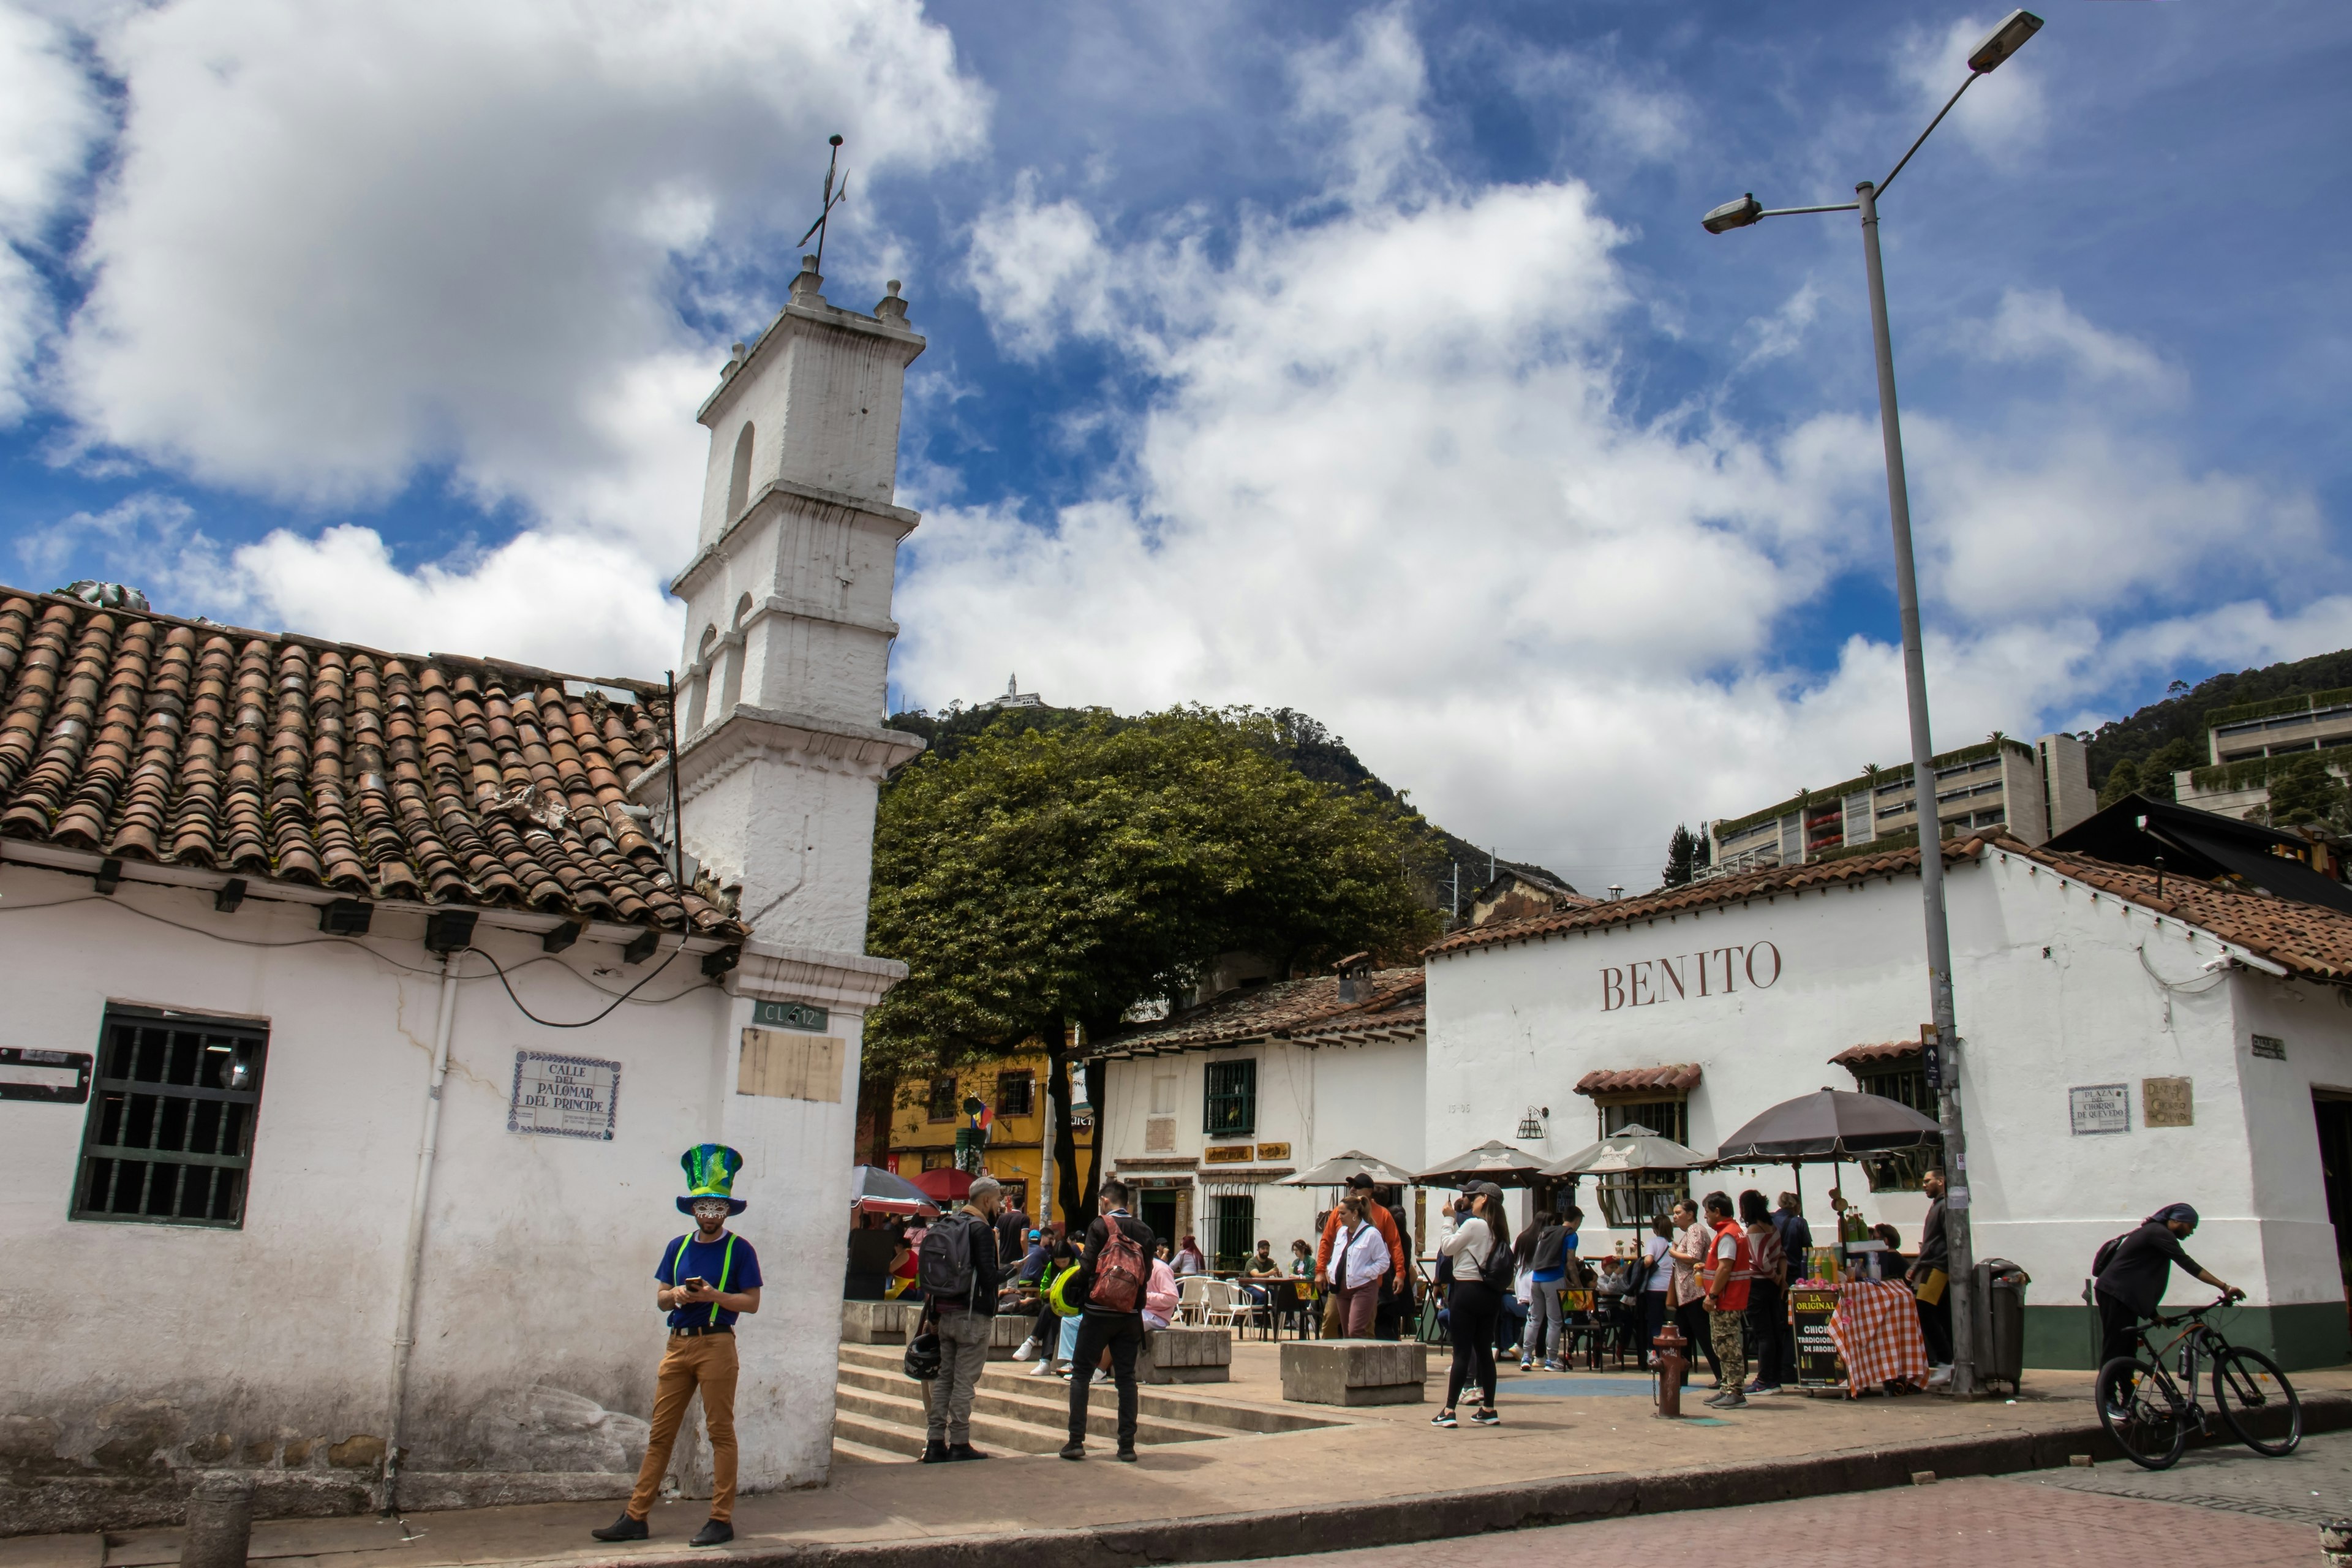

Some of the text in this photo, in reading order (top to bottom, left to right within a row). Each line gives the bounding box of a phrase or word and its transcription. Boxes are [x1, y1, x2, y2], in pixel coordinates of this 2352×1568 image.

[1599, 941, 1781, 1012] BENITO
[765, 1005, 783, 1021] CL
[549, 1064, 586, 1077] CALLE
[554, 1076, 576, 1085] DEL
[537, 1083, 594, 1099] PALOMAR
[526, 1095, 603, 1112] DEL PRINCIPE
[2089, 1110, 2124, 1118] QUEVEDO
[1804, 1325, 1828, 1334] CHICH
